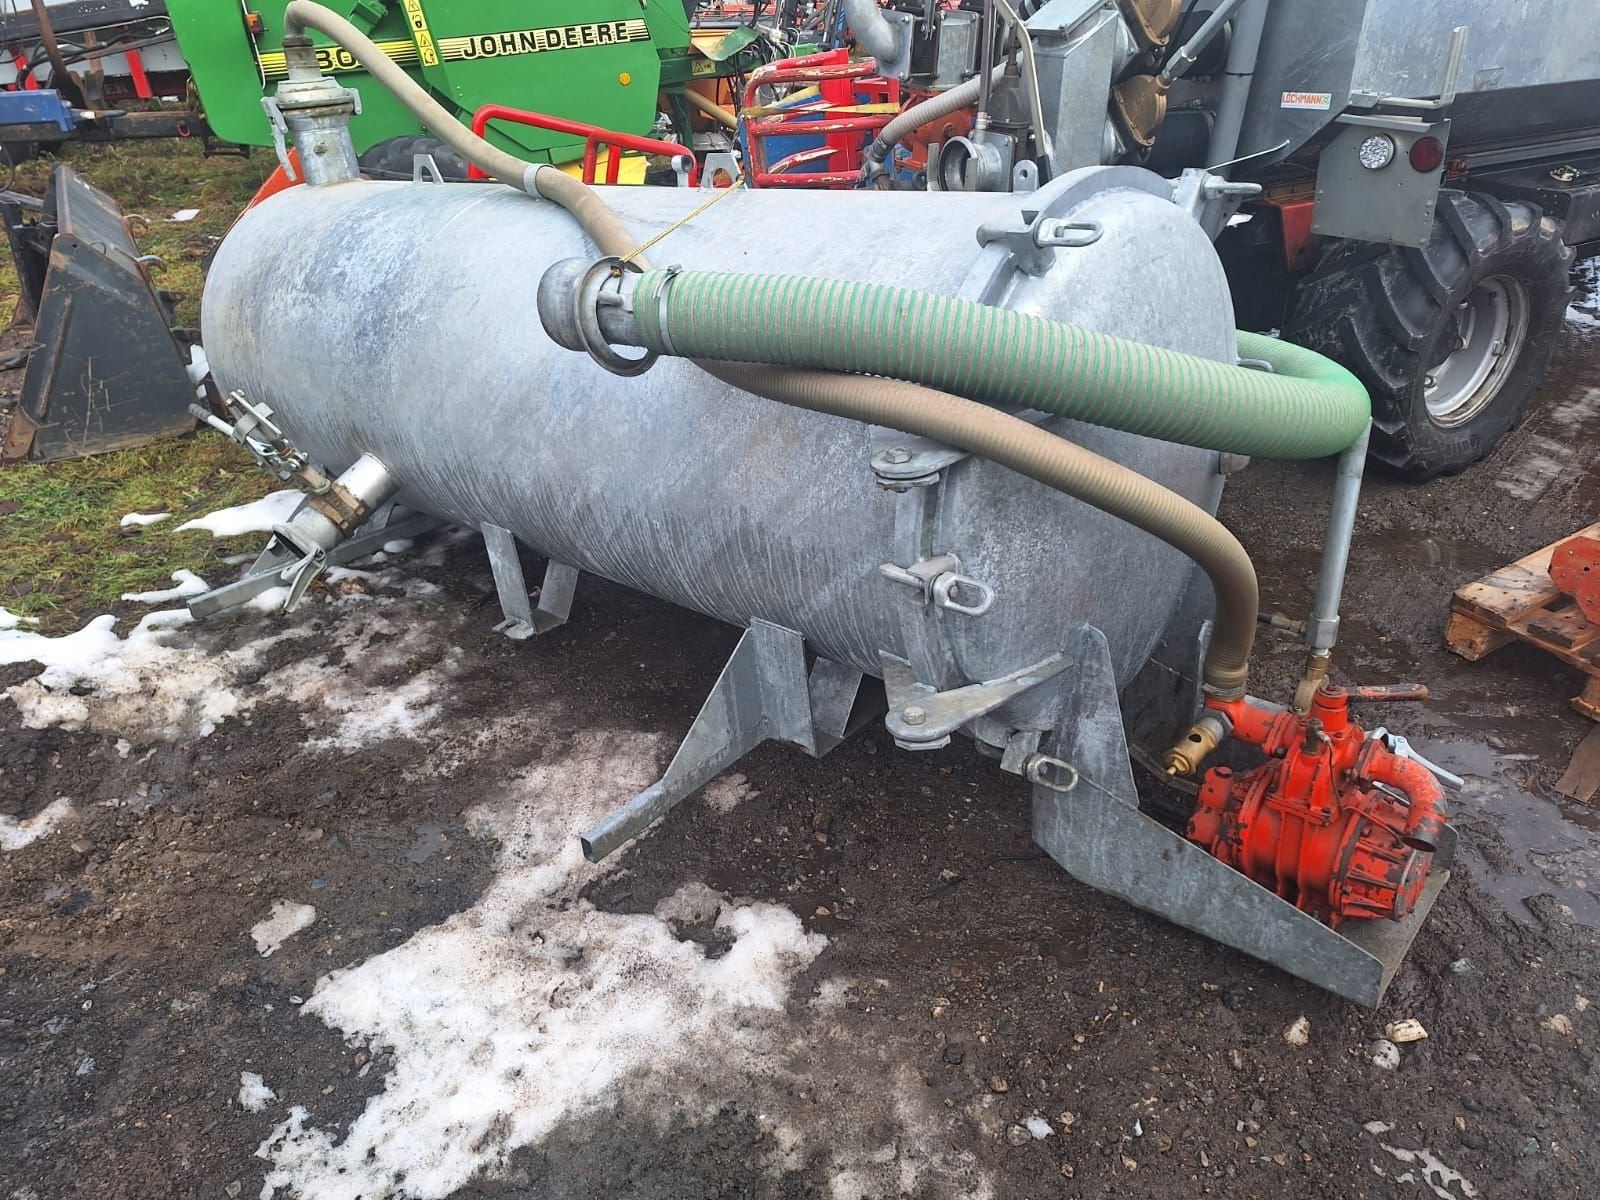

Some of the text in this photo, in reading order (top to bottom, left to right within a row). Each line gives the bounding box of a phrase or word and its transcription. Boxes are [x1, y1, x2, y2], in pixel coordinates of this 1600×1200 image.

[463, 22, 628, 58] JOHN DEERE
[1282, 93, 1322, 105] LOCHMANN
